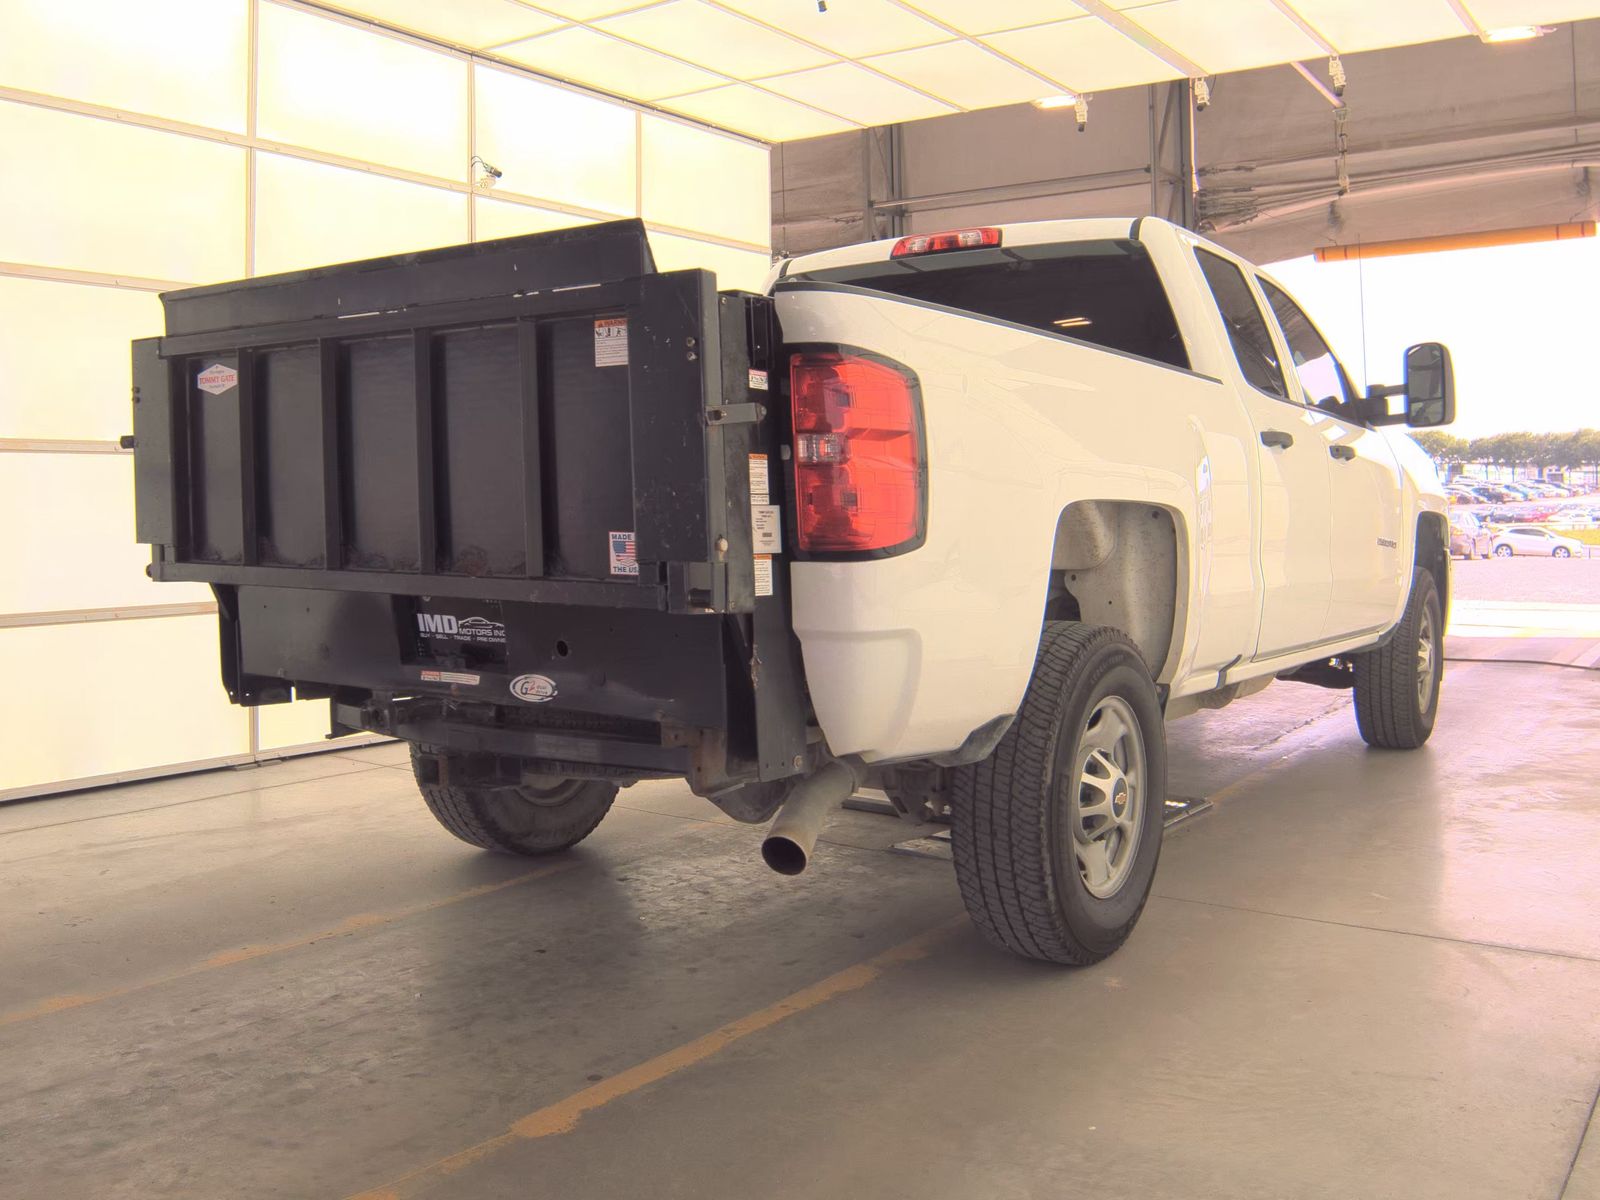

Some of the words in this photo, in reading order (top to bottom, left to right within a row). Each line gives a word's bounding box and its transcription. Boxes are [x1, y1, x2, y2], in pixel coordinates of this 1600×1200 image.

[200, 375, 219, 385] TOMMY
[221, 374, 235, 383] GATE
[611, 533, 633, 541] MADE
[628, 566, 639, 574] US
[417, 613, 458, 634] IMD
[459, 628, 493, 636] MOTORS
